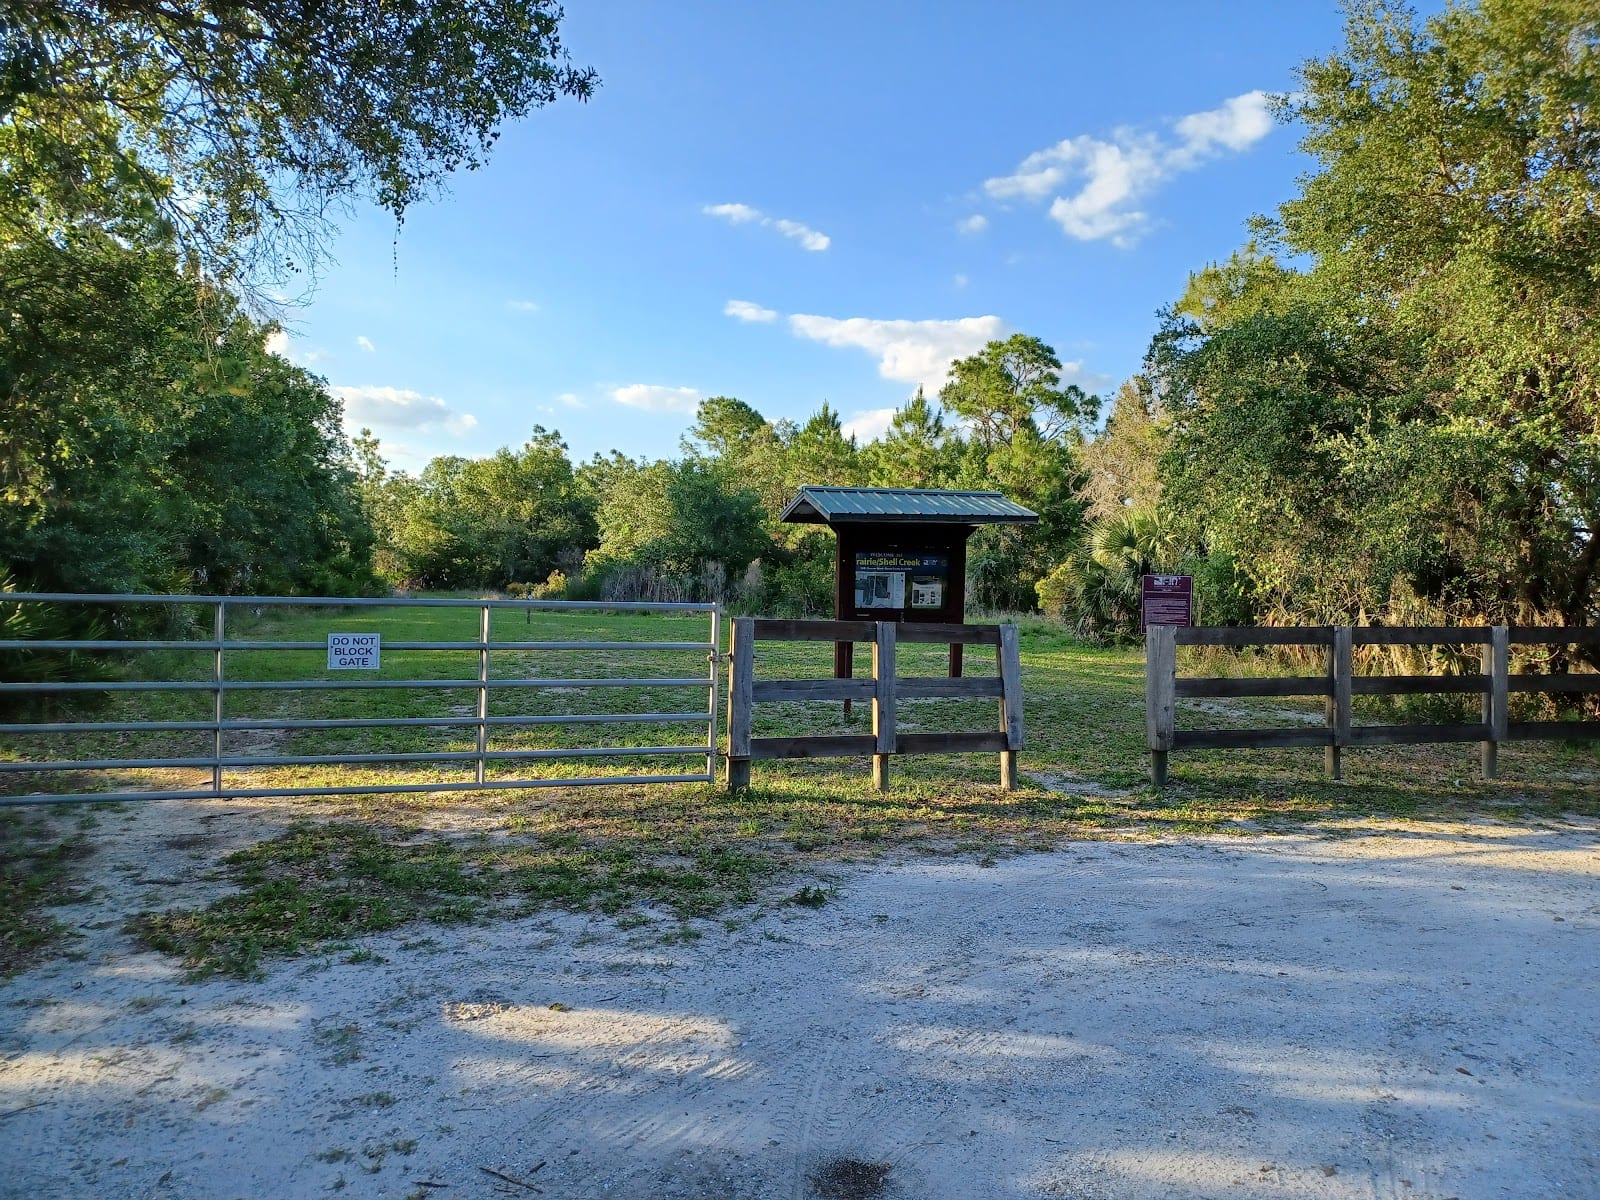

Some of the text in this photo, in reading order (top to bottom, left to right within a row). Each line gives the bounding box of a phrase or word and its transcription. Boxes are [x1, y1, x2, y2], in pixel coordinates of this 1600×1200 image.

[856, 557, 897, 566] rairie/Shell
[899, 558, 921, 566] Creek
[332, 637, 375, 645] DO NOT
[334, 647, 373, 655] BLOCK
[339, 657, 368, 665] GATE
